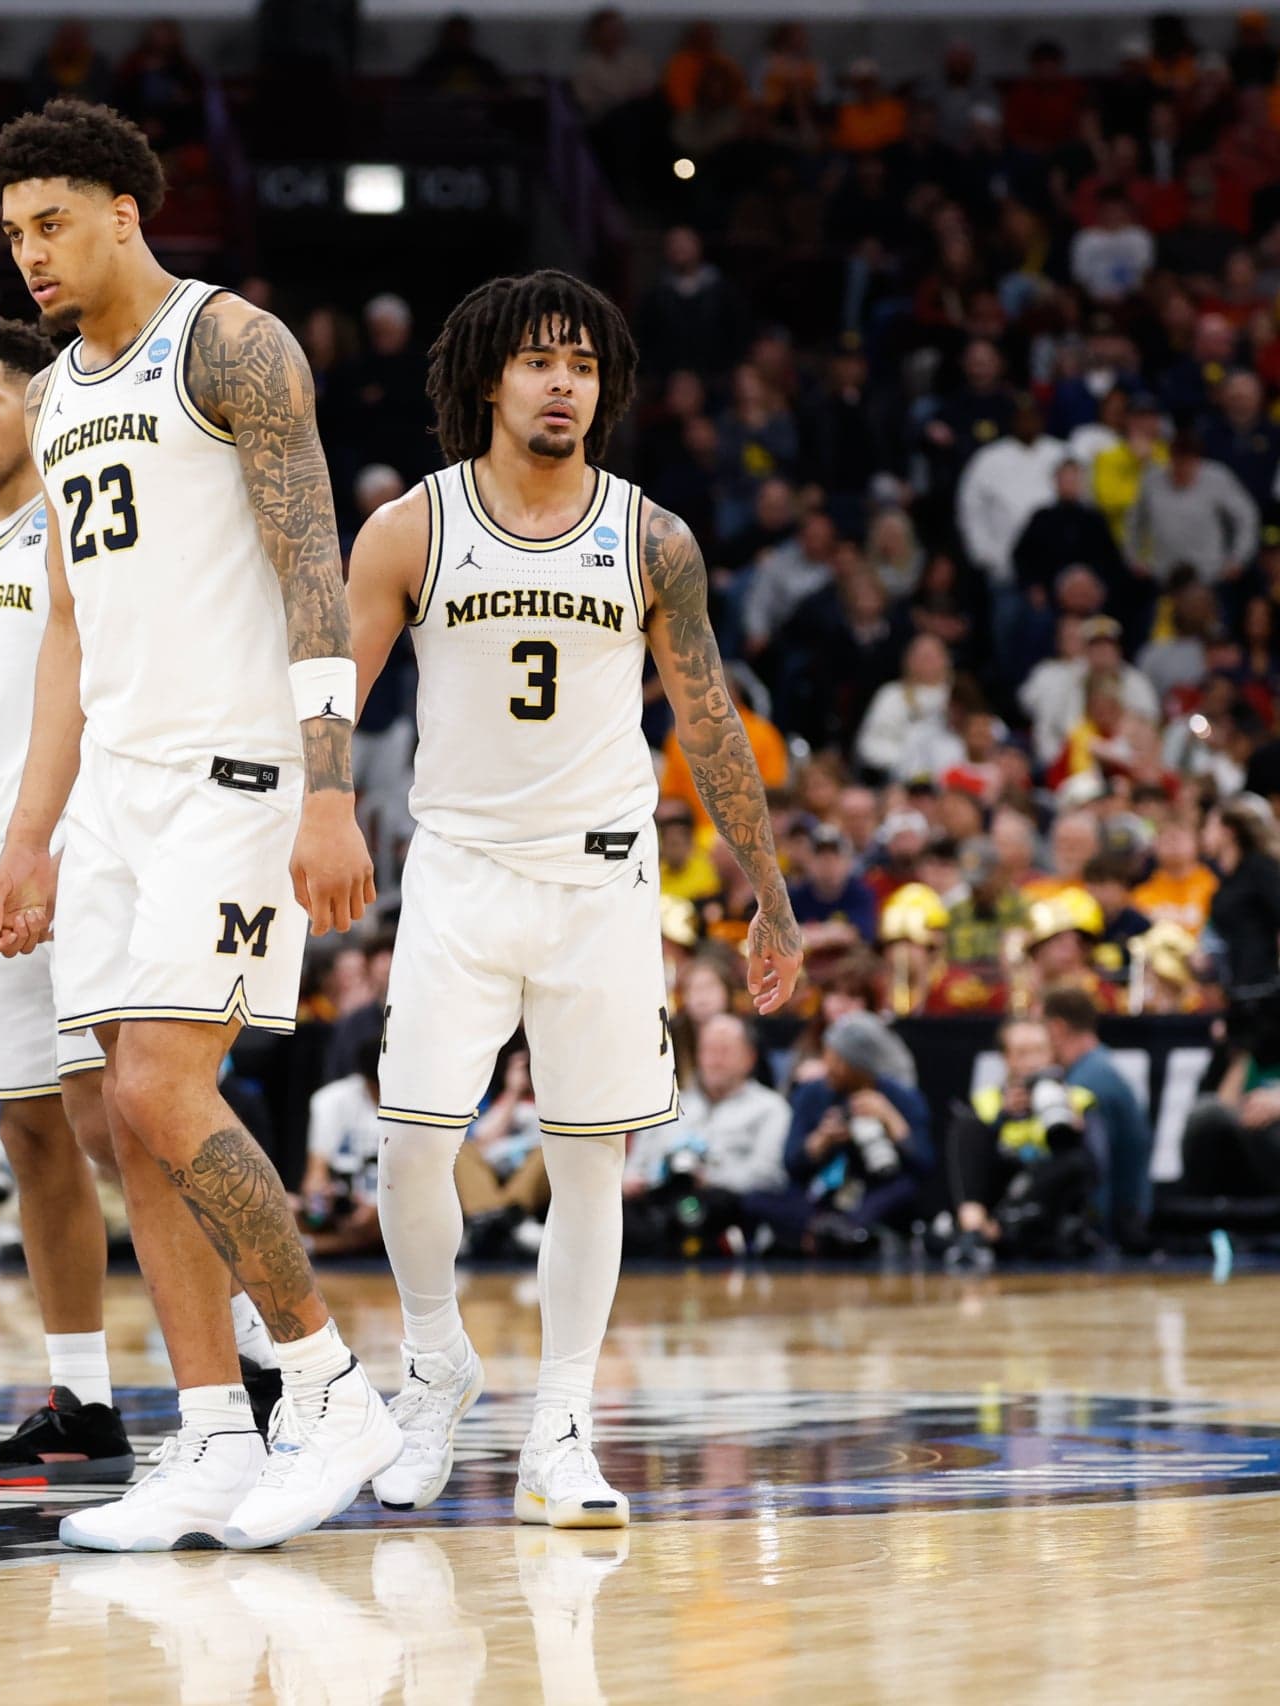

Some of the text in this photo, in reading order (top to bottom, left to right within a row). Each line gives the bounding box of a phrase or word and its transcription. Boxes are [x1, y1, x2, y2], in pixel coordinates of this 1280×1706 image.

[42, 413, 160, 477] MICHIGAN
[61, 462, 140, 565] 23
[444, 588, 626, 634] MICHIGAN
[508, 638, 560, 722] 3
[262, 770, 275, 783] 50
[215, 901, 278, 959] M
